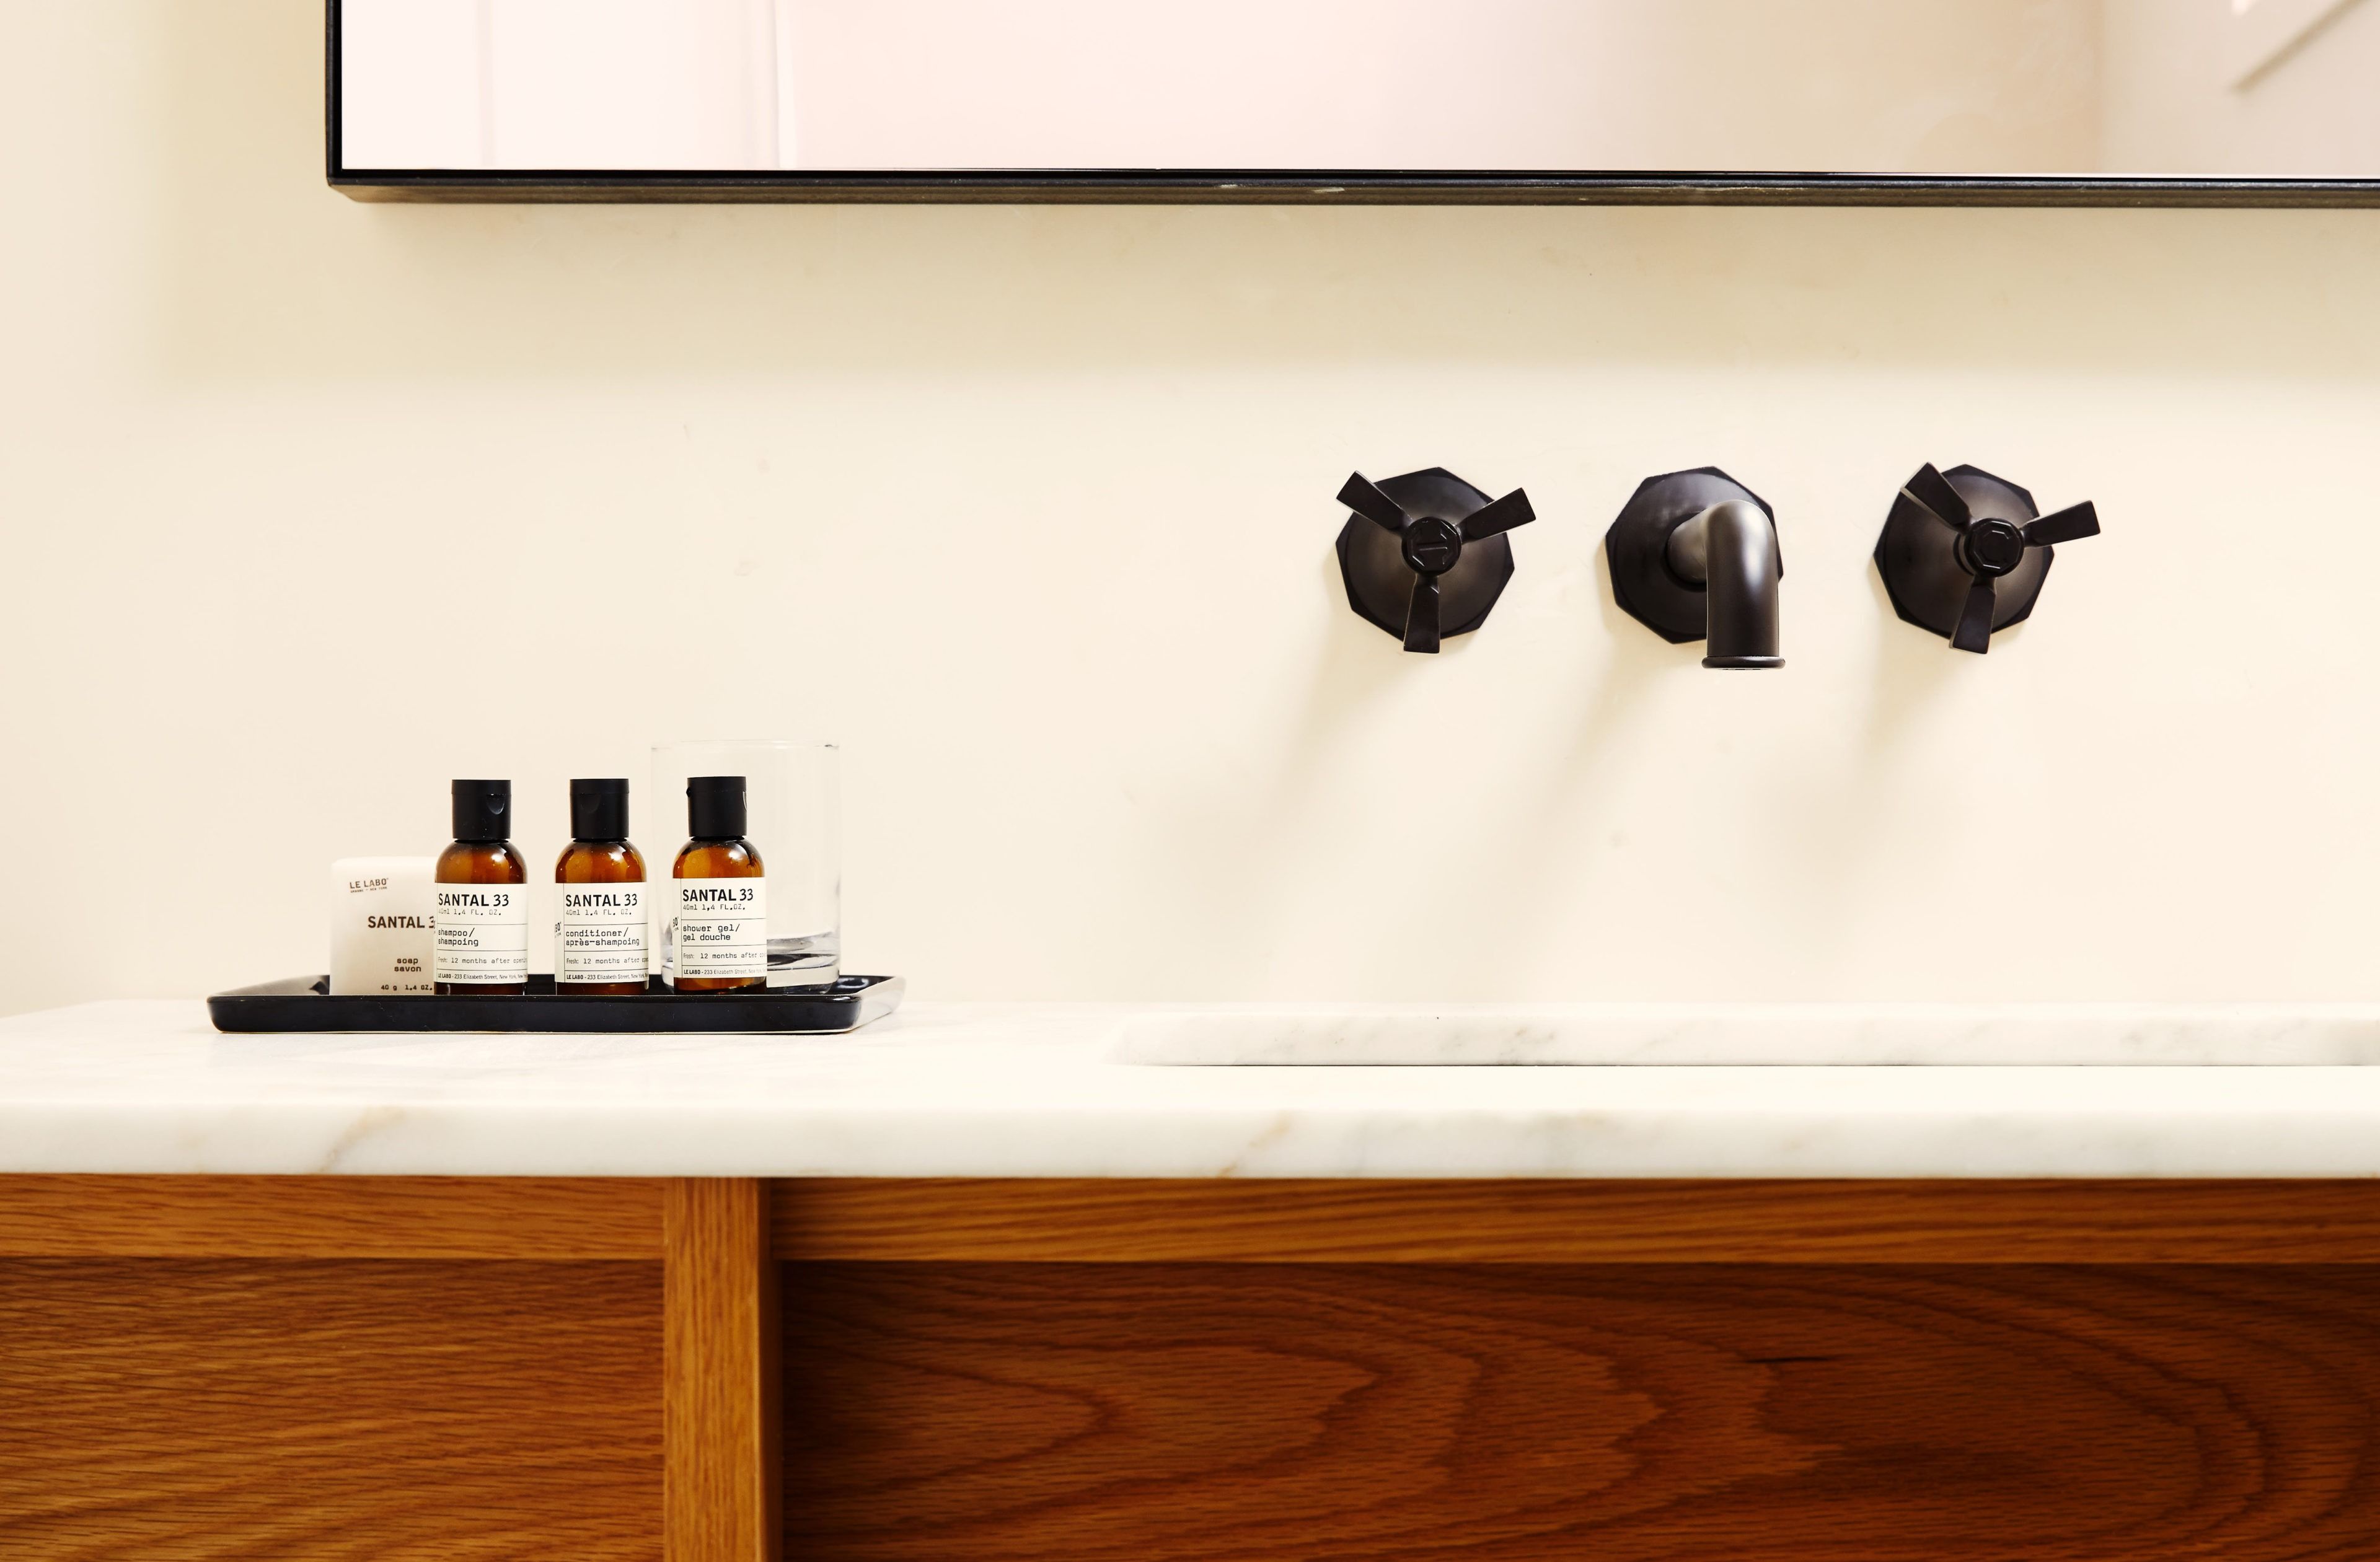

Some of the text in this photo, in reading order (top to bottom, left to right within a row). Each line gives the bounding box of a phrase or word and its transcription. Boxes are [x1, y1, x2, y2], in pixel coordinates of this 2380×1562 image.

[364, 878, 387, 887] LABO
[438, 893, 509, 906] SANTAL 33
[565, 893, 637, 906] SANTAL 33
[682, 888, 753, 902] SANTAL 33
[368, 916, 434, 928] SANTAL 3
[438, 928, 475, 937] shampoo/
[566, 927, 628, 937] conditioner/
[718, 924, 740, 932] gel/
[438, 937, 478, 947] shampoing
[566, 937, 640, 947] après-shampoing
[683, 934, 695, 942] gel
